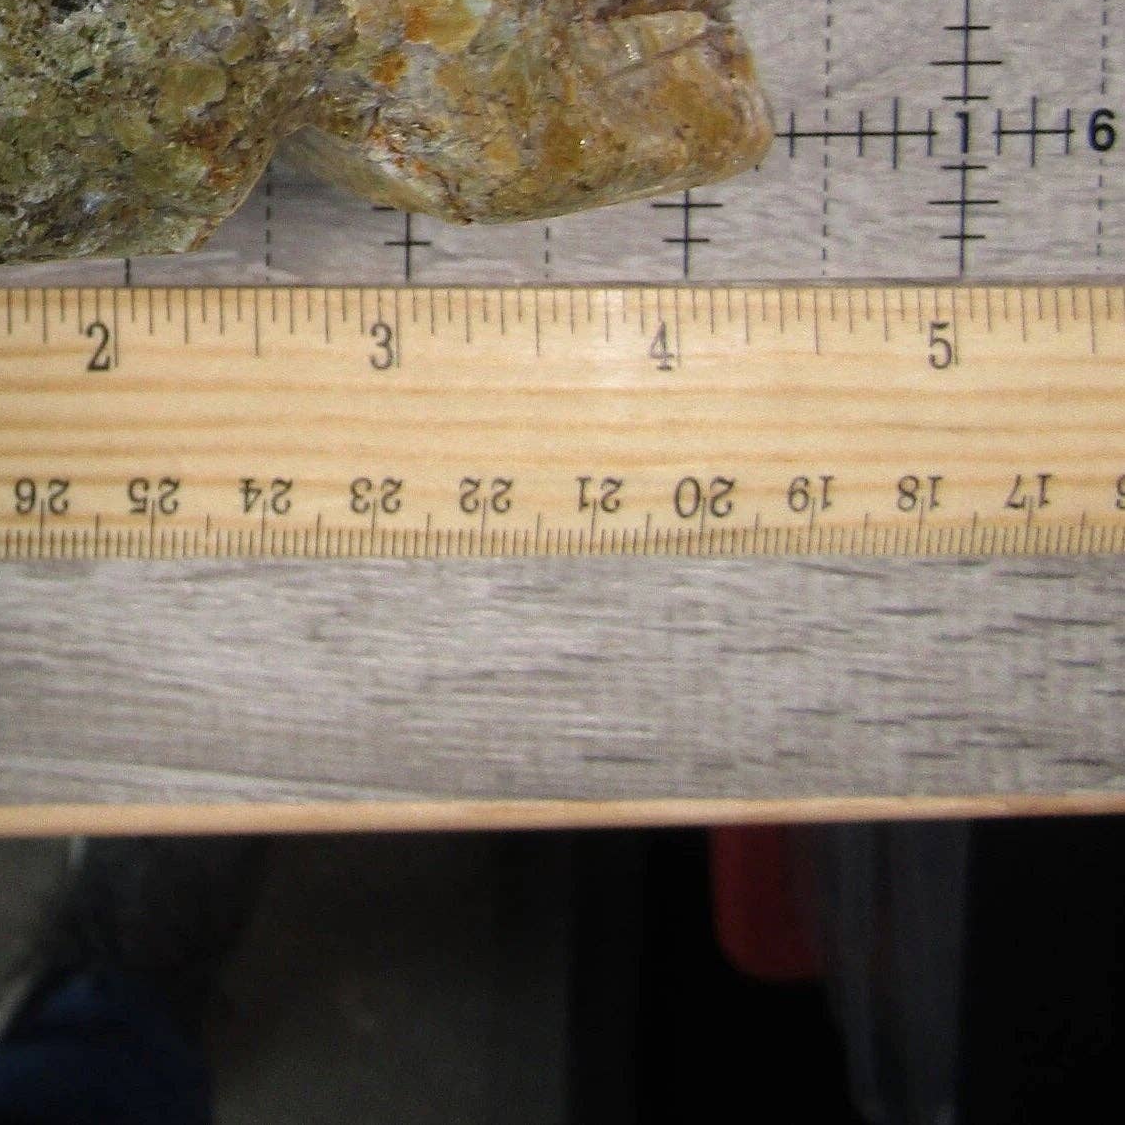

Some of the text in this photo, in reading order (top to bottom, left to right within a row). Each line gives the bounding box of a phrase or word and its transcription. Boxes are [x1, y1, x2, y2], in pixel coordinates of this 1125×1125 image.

[957, 112, 971, 154] 1
[1087, 108, 1116, 152] 6
[86, 323, 112, 372] 2
[368, 322, 394, 370] 3
[649, 321, 674, 370] 4
[929, 321, 953, 370] 5
[14, 478, 69, 514] 26
[128, 477, 179, 514] 25
[240, 477, 292, 514] 24
[349, 477, 402, 513] 23
[459, 477, 512, 513] 22
[577, 476, 623, 513] 21
[675, 476, 735, 516] 20
[787, 476, 835, 512] 19
[897, 475, 942, 511] 18
[1003, 473, 1053, 509] 17
